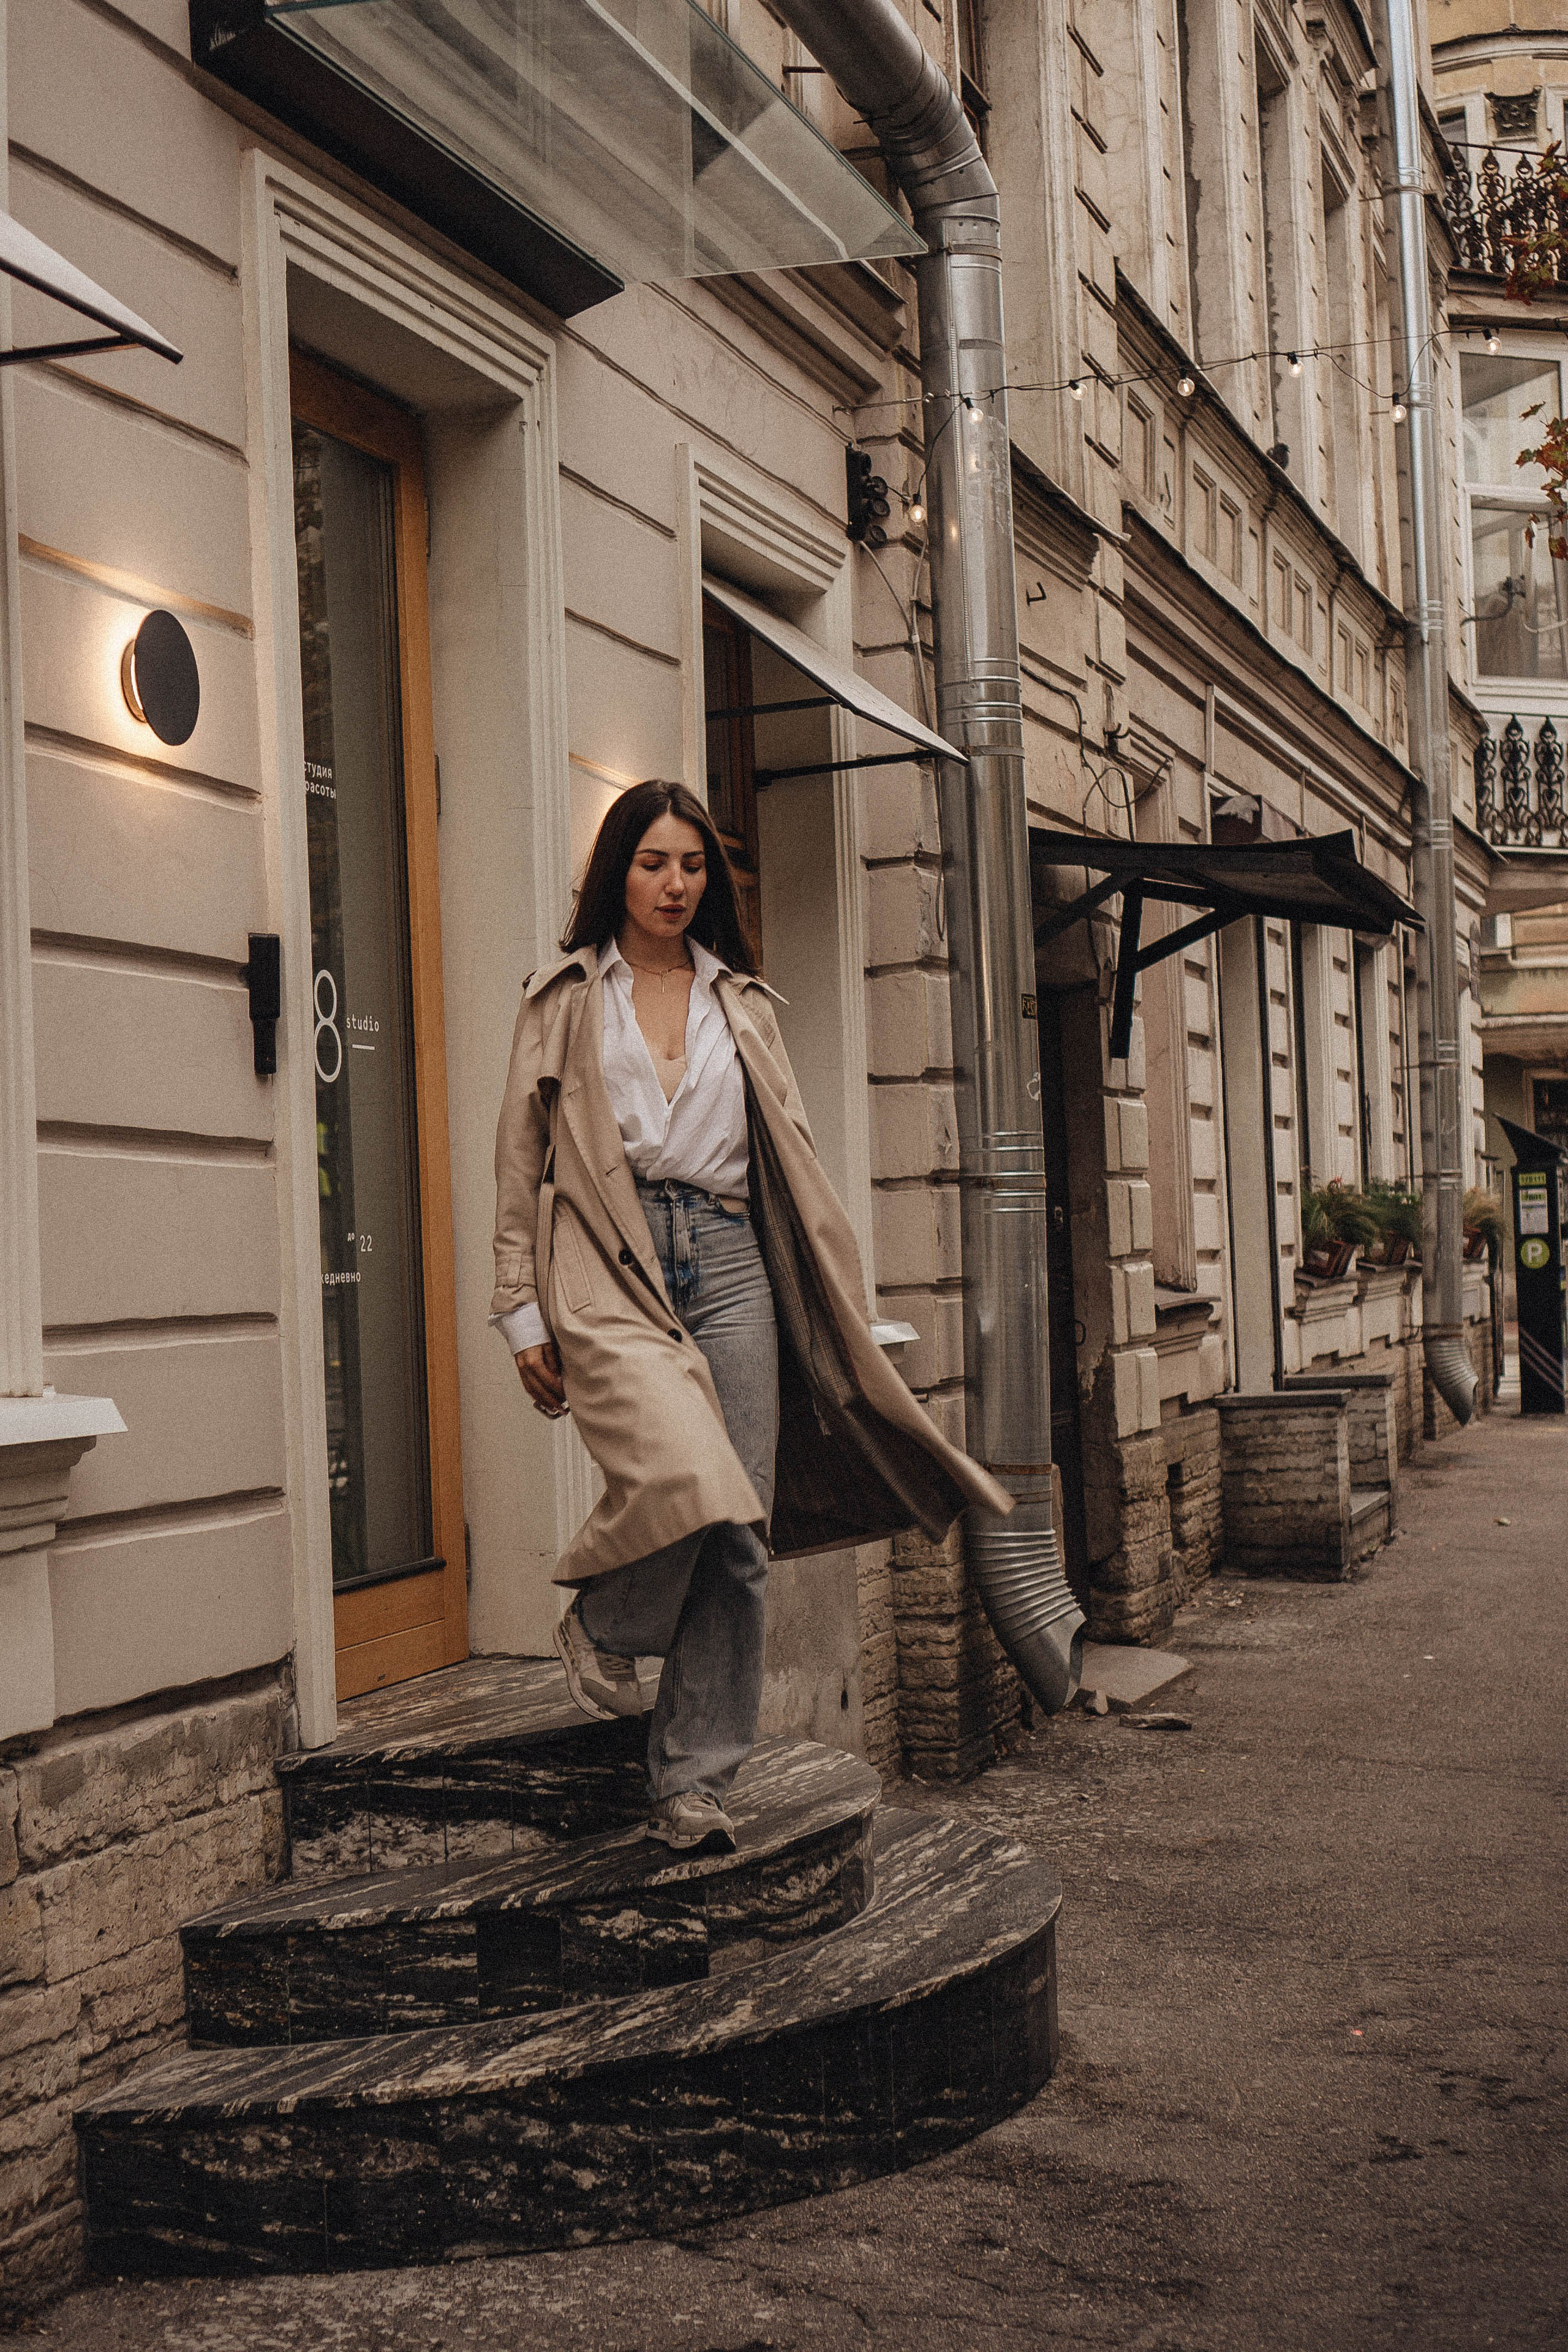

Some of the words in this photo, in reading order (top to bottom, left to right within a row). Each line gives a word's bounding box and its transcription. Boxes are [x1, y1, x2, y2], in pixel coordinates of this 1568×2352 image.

[314, 970, 342, 1082] 8
[346, 1014, 380, 1032] studio
[347, 1232, 355, 1242] до
[360, 1235, 372, 1252] 22
[1528, 1243, 1542, 1264] P
